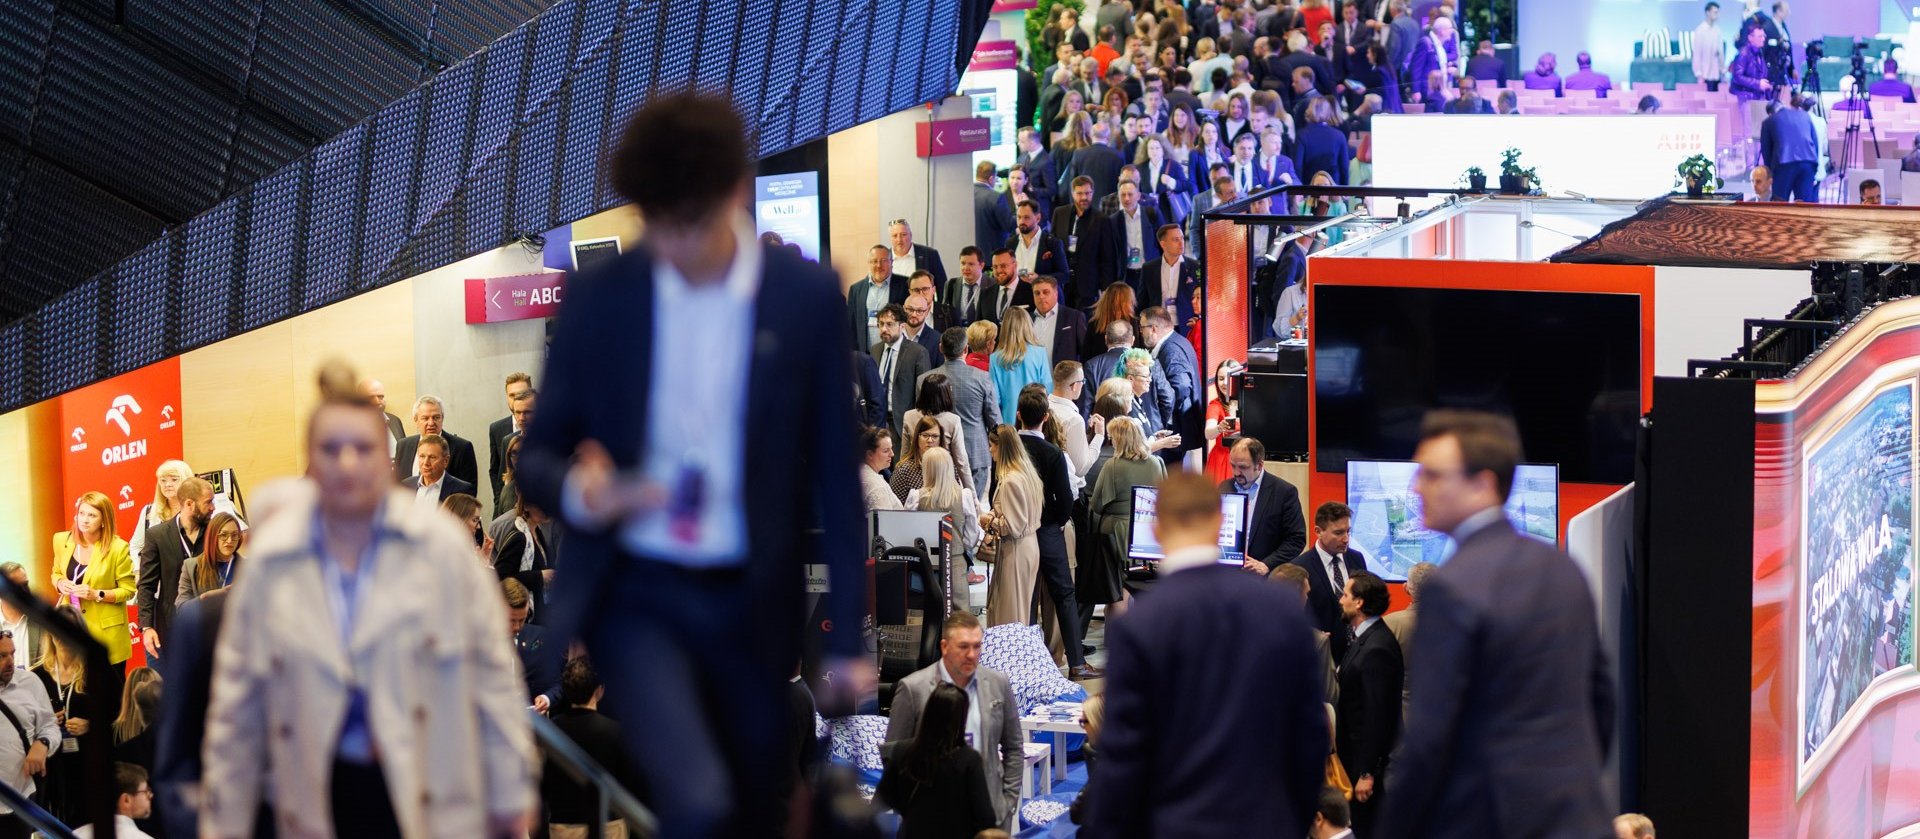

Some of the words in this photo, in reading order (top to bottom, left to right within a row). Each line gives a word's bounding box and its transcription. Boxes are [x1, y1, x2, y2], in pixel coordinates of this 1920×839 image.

[511, 289, 527, 298] Hala
[529, 286, 562, 305] ABC
[160, 420, 176, 430] ORLEN
[70, 443, 87, 452] ORLEN
[101, 439, 147, 466] ORLEN
[119, 500, 135, 510] ORLEN
[1811, 543, 1857, 625] STALOWA
[1857, 514, 1892, 573] WOLA
